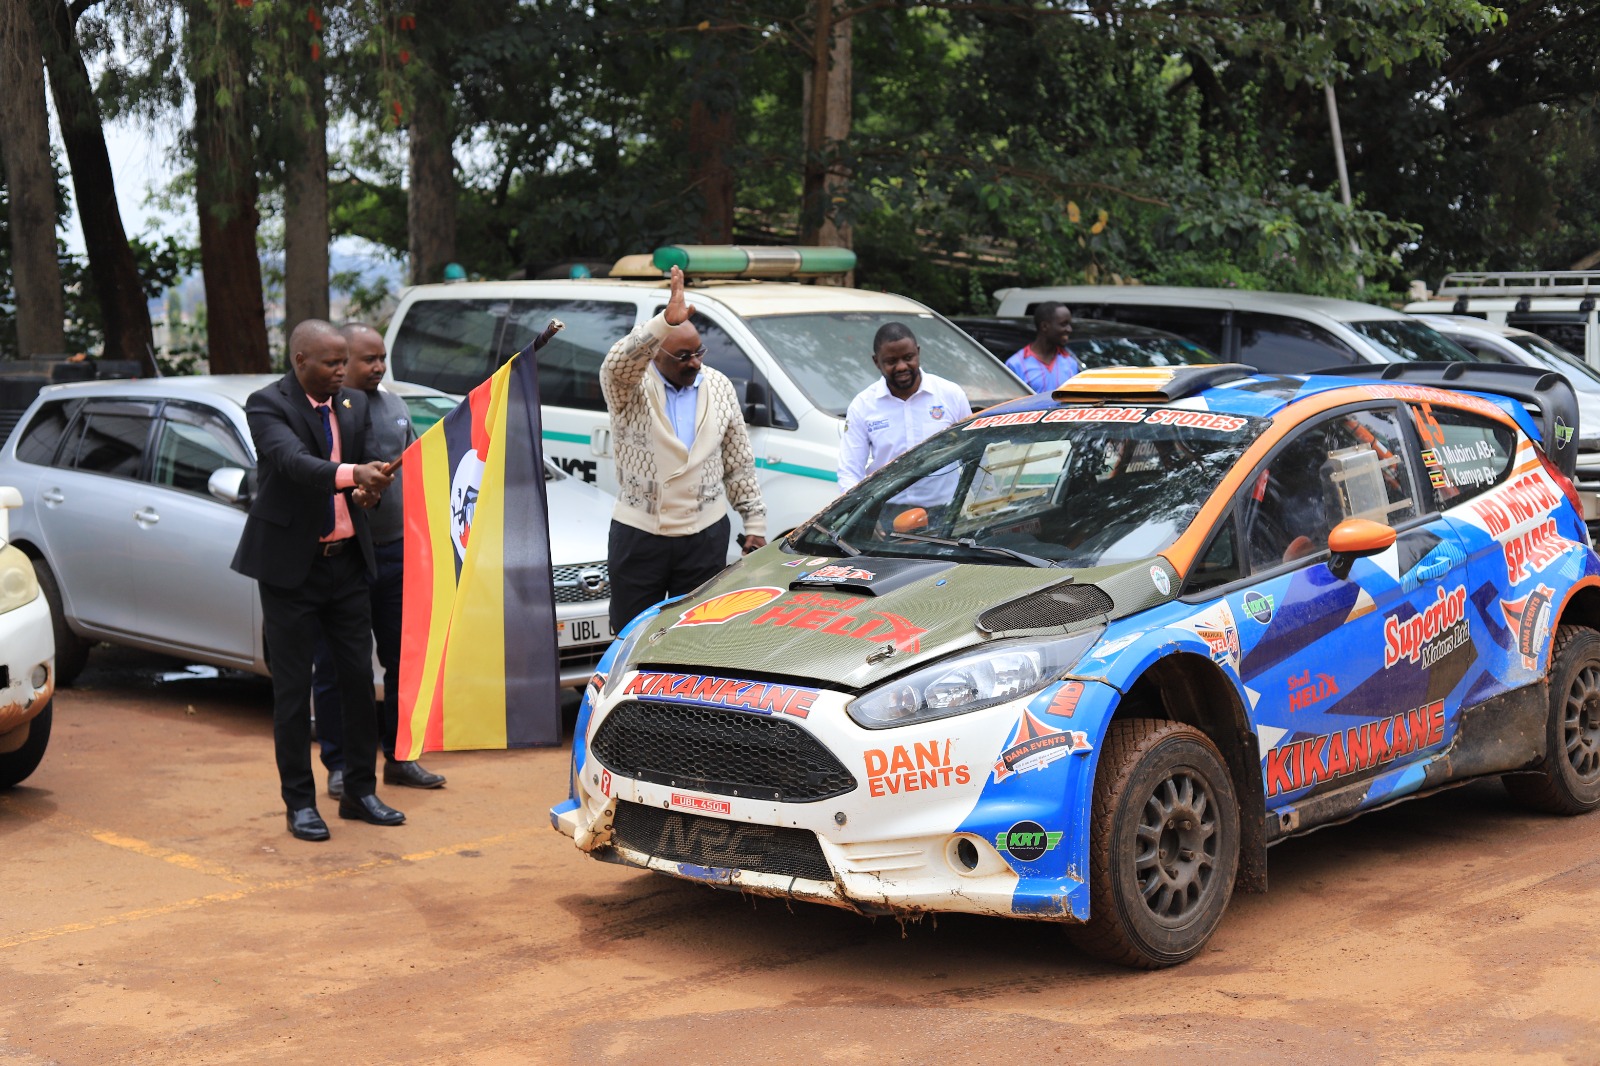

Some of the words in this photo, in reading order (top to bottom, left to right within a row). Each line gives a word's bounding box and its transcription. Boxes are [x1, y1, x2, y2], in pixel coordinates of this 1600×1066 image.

[1042, 408, 1146, 423] GENERAL
[1145, 409, 1248, 431] STORES
[1412, 402, 1445, 446] 45
[1431, 447, 1446, 466] D.
[1442, 444, 1478, 465] Mubiru
[1475, 440, 1496, 460] AB+
[1451, 467, 1485, 488] Kamya
[1482, 466, 1497, 485] B+
[1471, 498, 1511, 537] MD
[1494, 472, 1560, 525] MOTOR
[1504, 519, 1577, 583] SPARES
[784, 592, 868, 610] Shell
[1525, 596, 1541, 628] EVENTS
[571, 620, 601, 641] UBL
[751, 606, 929, 654] HELIX
[1384, 584, 1467, 670] Superior
[1523, 628, 1531, 654] DANA
[1421, 634, 1454, 670] Motors
[1453, 618, 1470, 649] Ltd
[622, 672, 820, 720] KIKANKANE
[1287, 669, 1310, 691] Shell
[1288, 673, 1341, 713] HELIX
[1045, 681, 1085, 719] MD
[1267, 698, 1445, 799] KIKANKANE
[868, 765, 971, 798] EVENTS
[679, 797, 699, 809] UBL
[700, 801, 726, 813] 450L
[1009, 832, 1045, 847] KRT
